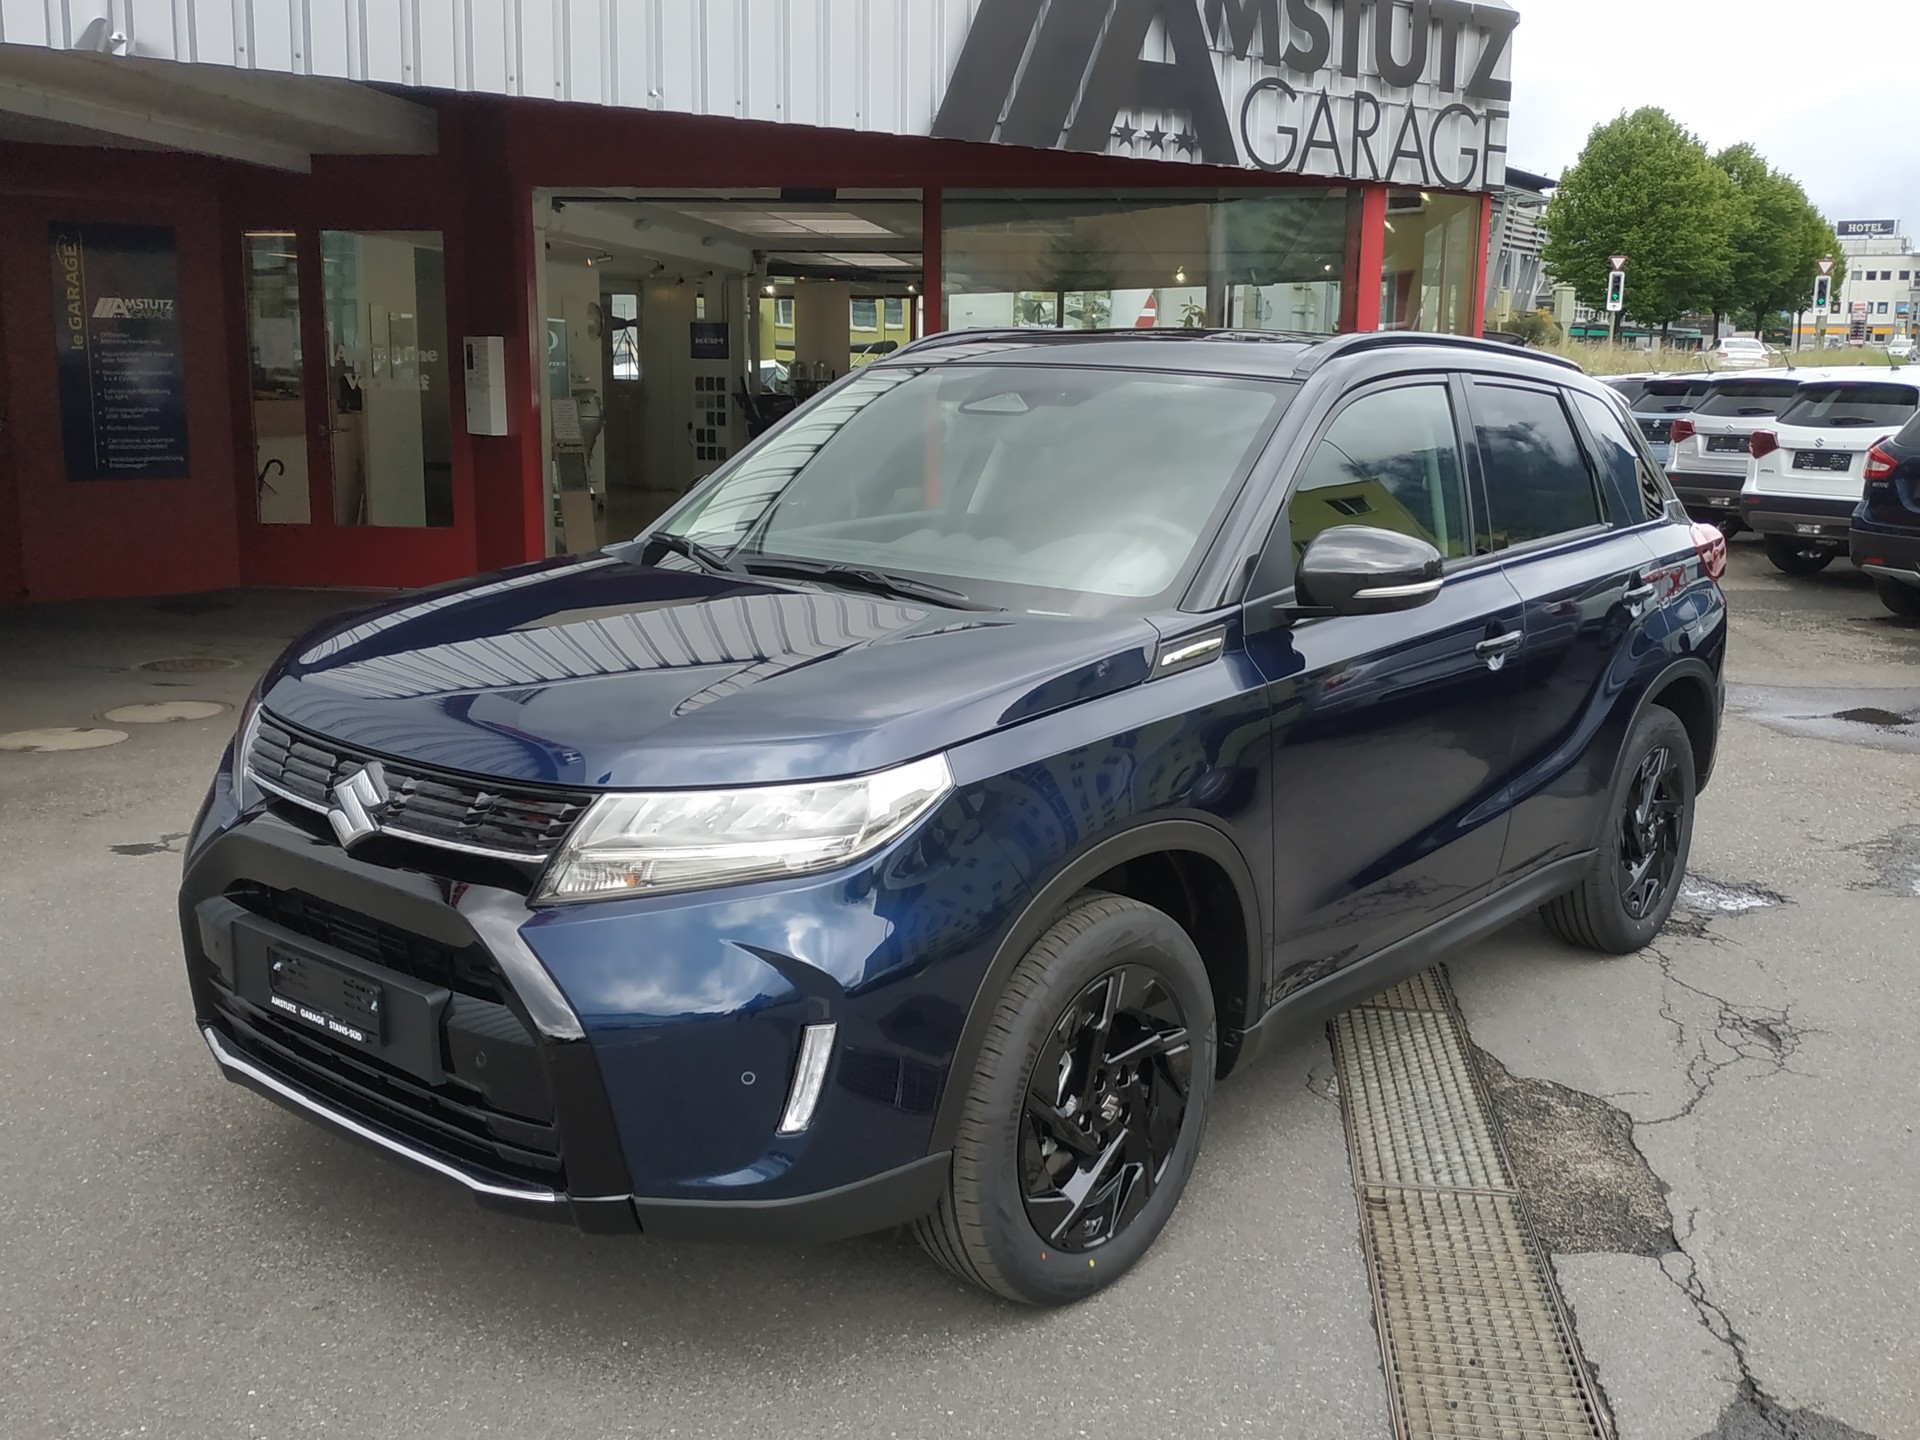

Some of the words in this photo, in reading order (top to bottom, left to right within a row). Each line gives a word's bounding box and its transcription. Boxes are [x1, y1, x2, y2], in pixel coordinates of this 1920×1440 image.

[1063, 0, 1520, 166] AMSTUTZ
[1240, 77, 1513, 193] GARAGE
[1847, 223, 1884, 233] HOTEL
[63, 243, 82, 330] GARAGE
[111, 297, 174, 318] AMSTUTZ
[70, 336, 84, 350] le
[271, 996, 297, 1013] AMSTUTZ
[300, 1008, 325, 1026] GARAGE
[328, 1020, 362, 1041] STANS-SÜD
